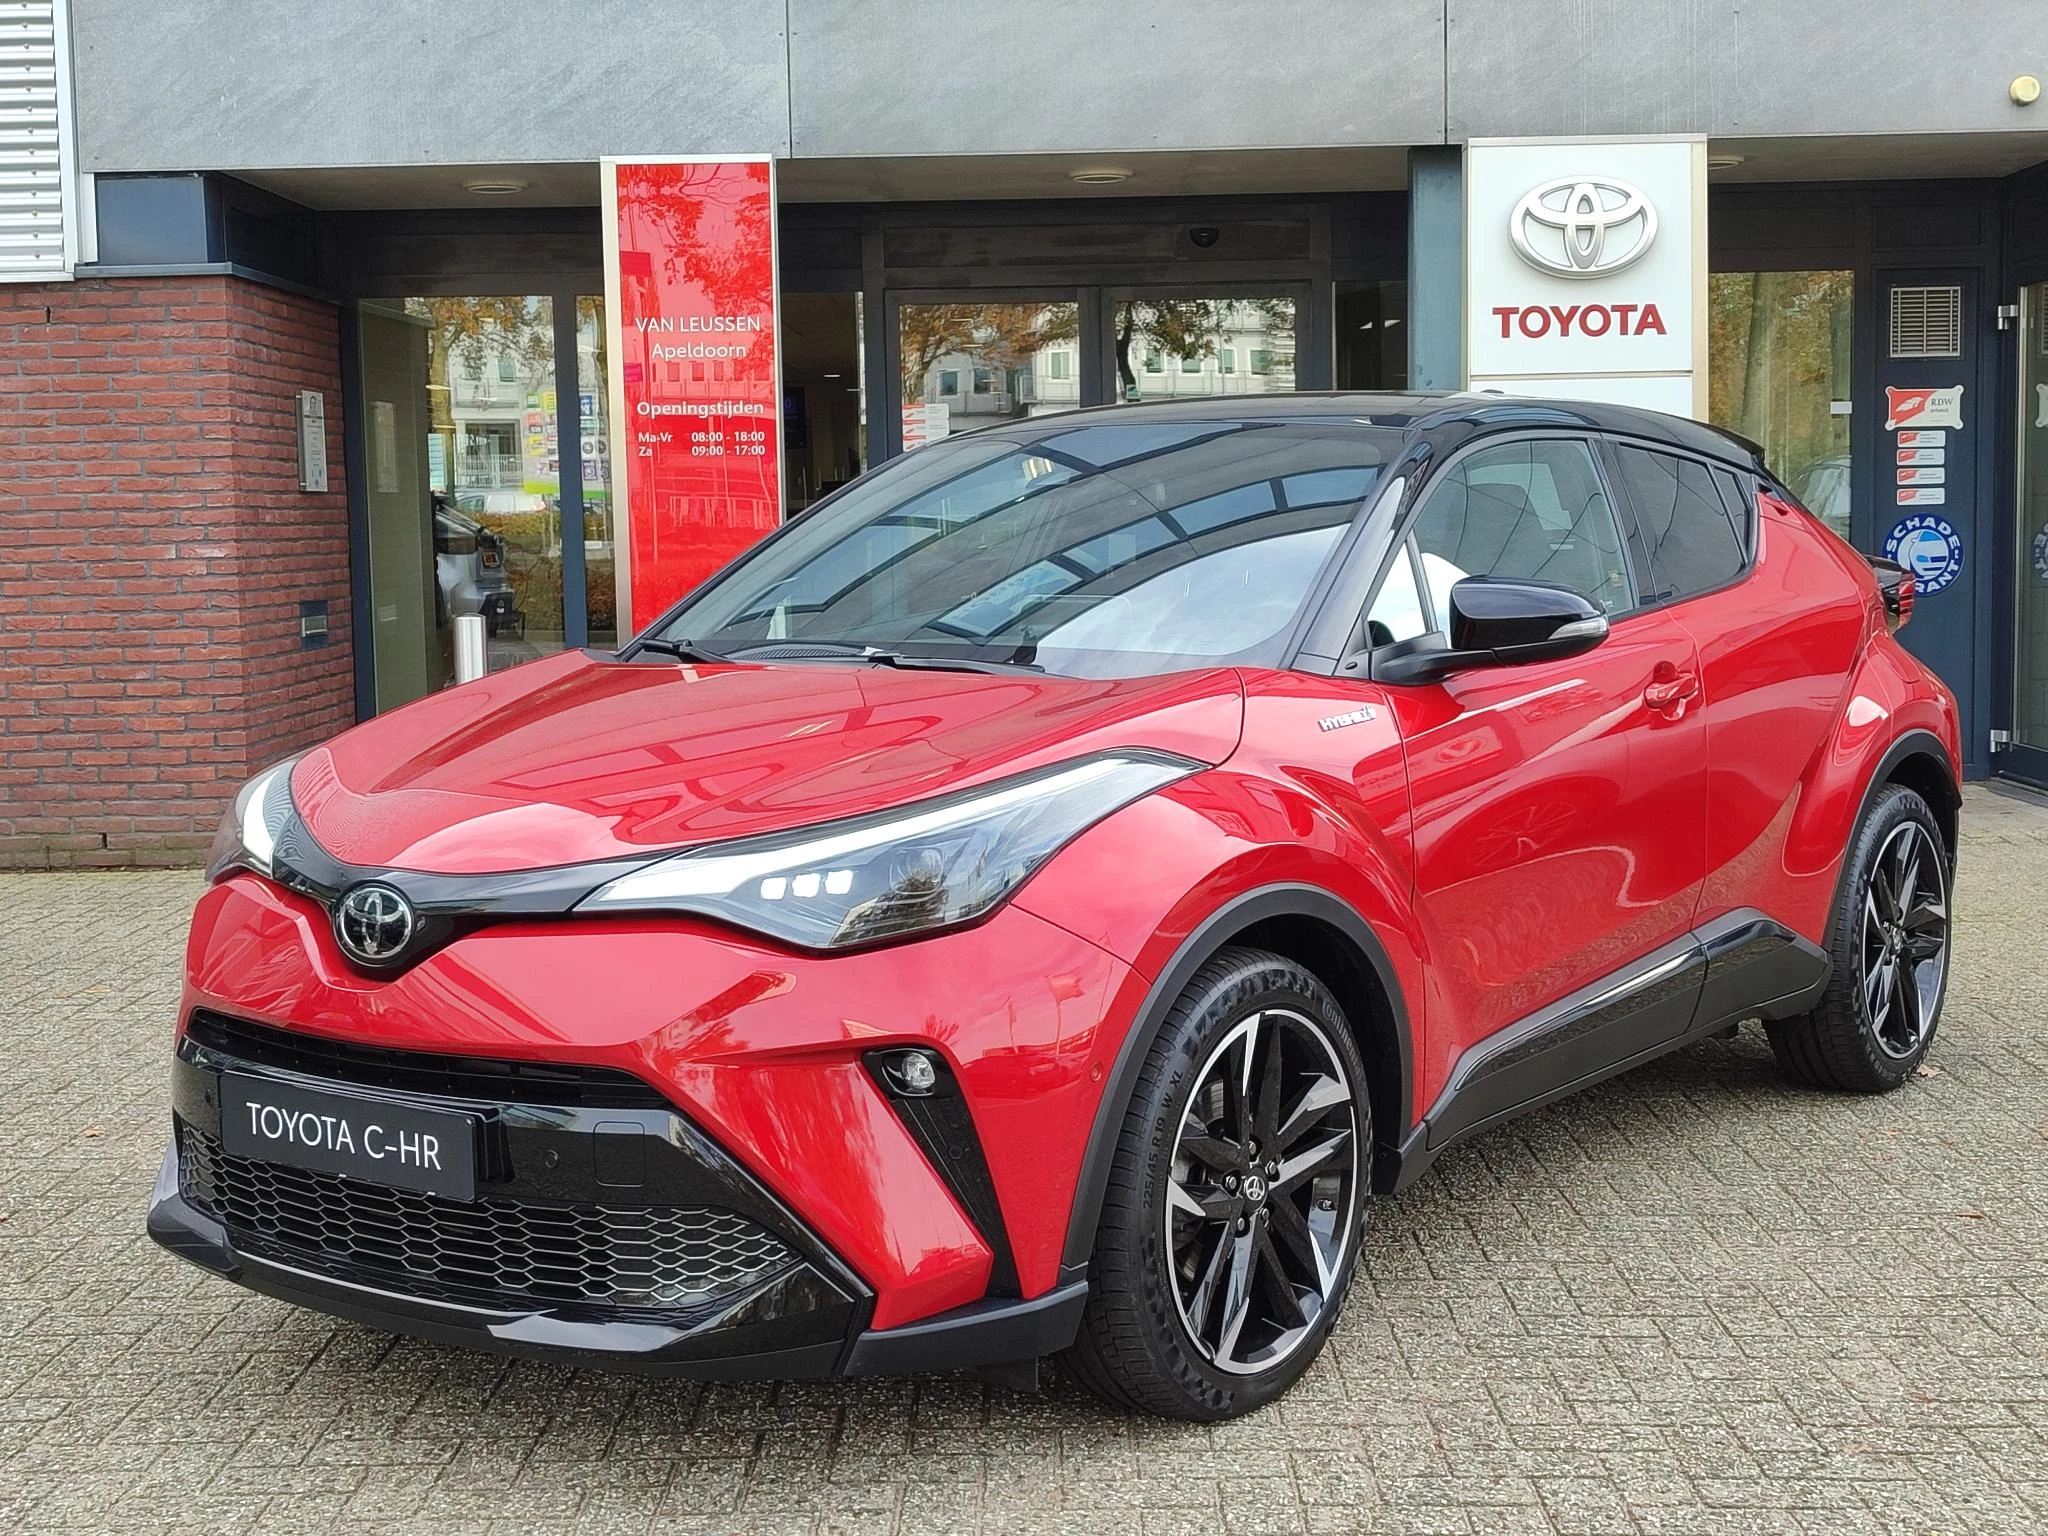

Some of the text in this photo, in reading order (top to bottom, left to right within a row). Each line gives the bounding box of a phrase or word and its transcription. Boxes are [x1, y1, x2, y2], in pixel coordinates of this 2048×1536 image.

[635, 316, 760, 333] VAN LEUSSEN
[1492, 304, 1667, 339] TOYOTA
[652, 343, 746, 361] Apeldoorn
[637, 401, 764, 419] Openingstijden
[1931, 398, 1953, 406] RDW
[638, 433, 673, 443] Ma-Vr
[691, 432, 723, 442] 08:00
[734, 431, 765, 442] 18:00
[638, 446, 653, 457] Za
[691, 446, 723, 456] 09:00
[734, 445, 765, 456] 17:00
[1886, 516, 1961, 552] SCHADE
[1915, 560, 1960, 593] RANT
[246, 1102, 442, 1171] TOYOTA C-HR
[1143, 1154, 1158, 1209] 225/45
[1169, 1069, 1184, 1088] XL
